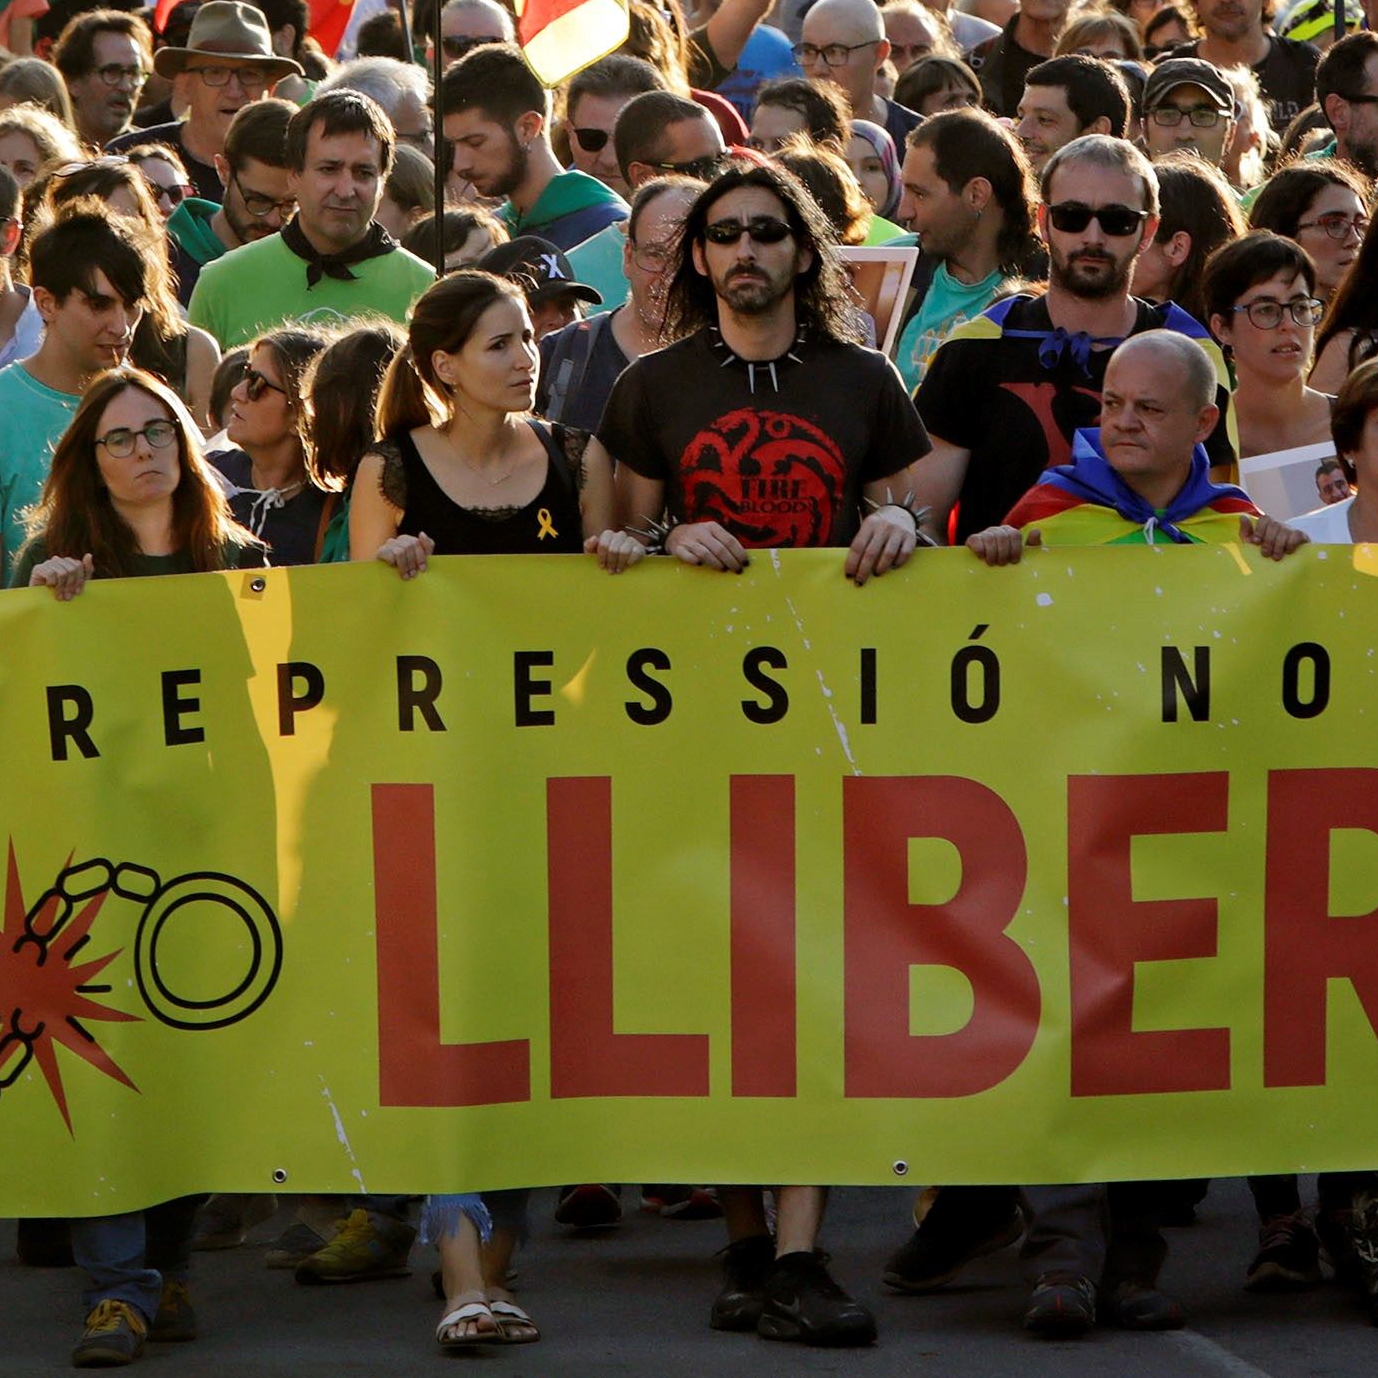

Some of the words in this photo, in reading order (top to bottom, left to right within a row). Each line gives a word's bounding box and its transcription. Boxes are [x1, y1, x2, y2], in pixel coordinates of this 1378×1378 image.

[740, 477, 807, 499] FIRE
[740, 499, 808, 514] BLOOD
[45, 623, 1002, 763] REPRESSIÓ
[1160, 640, 1332, 724] NO
